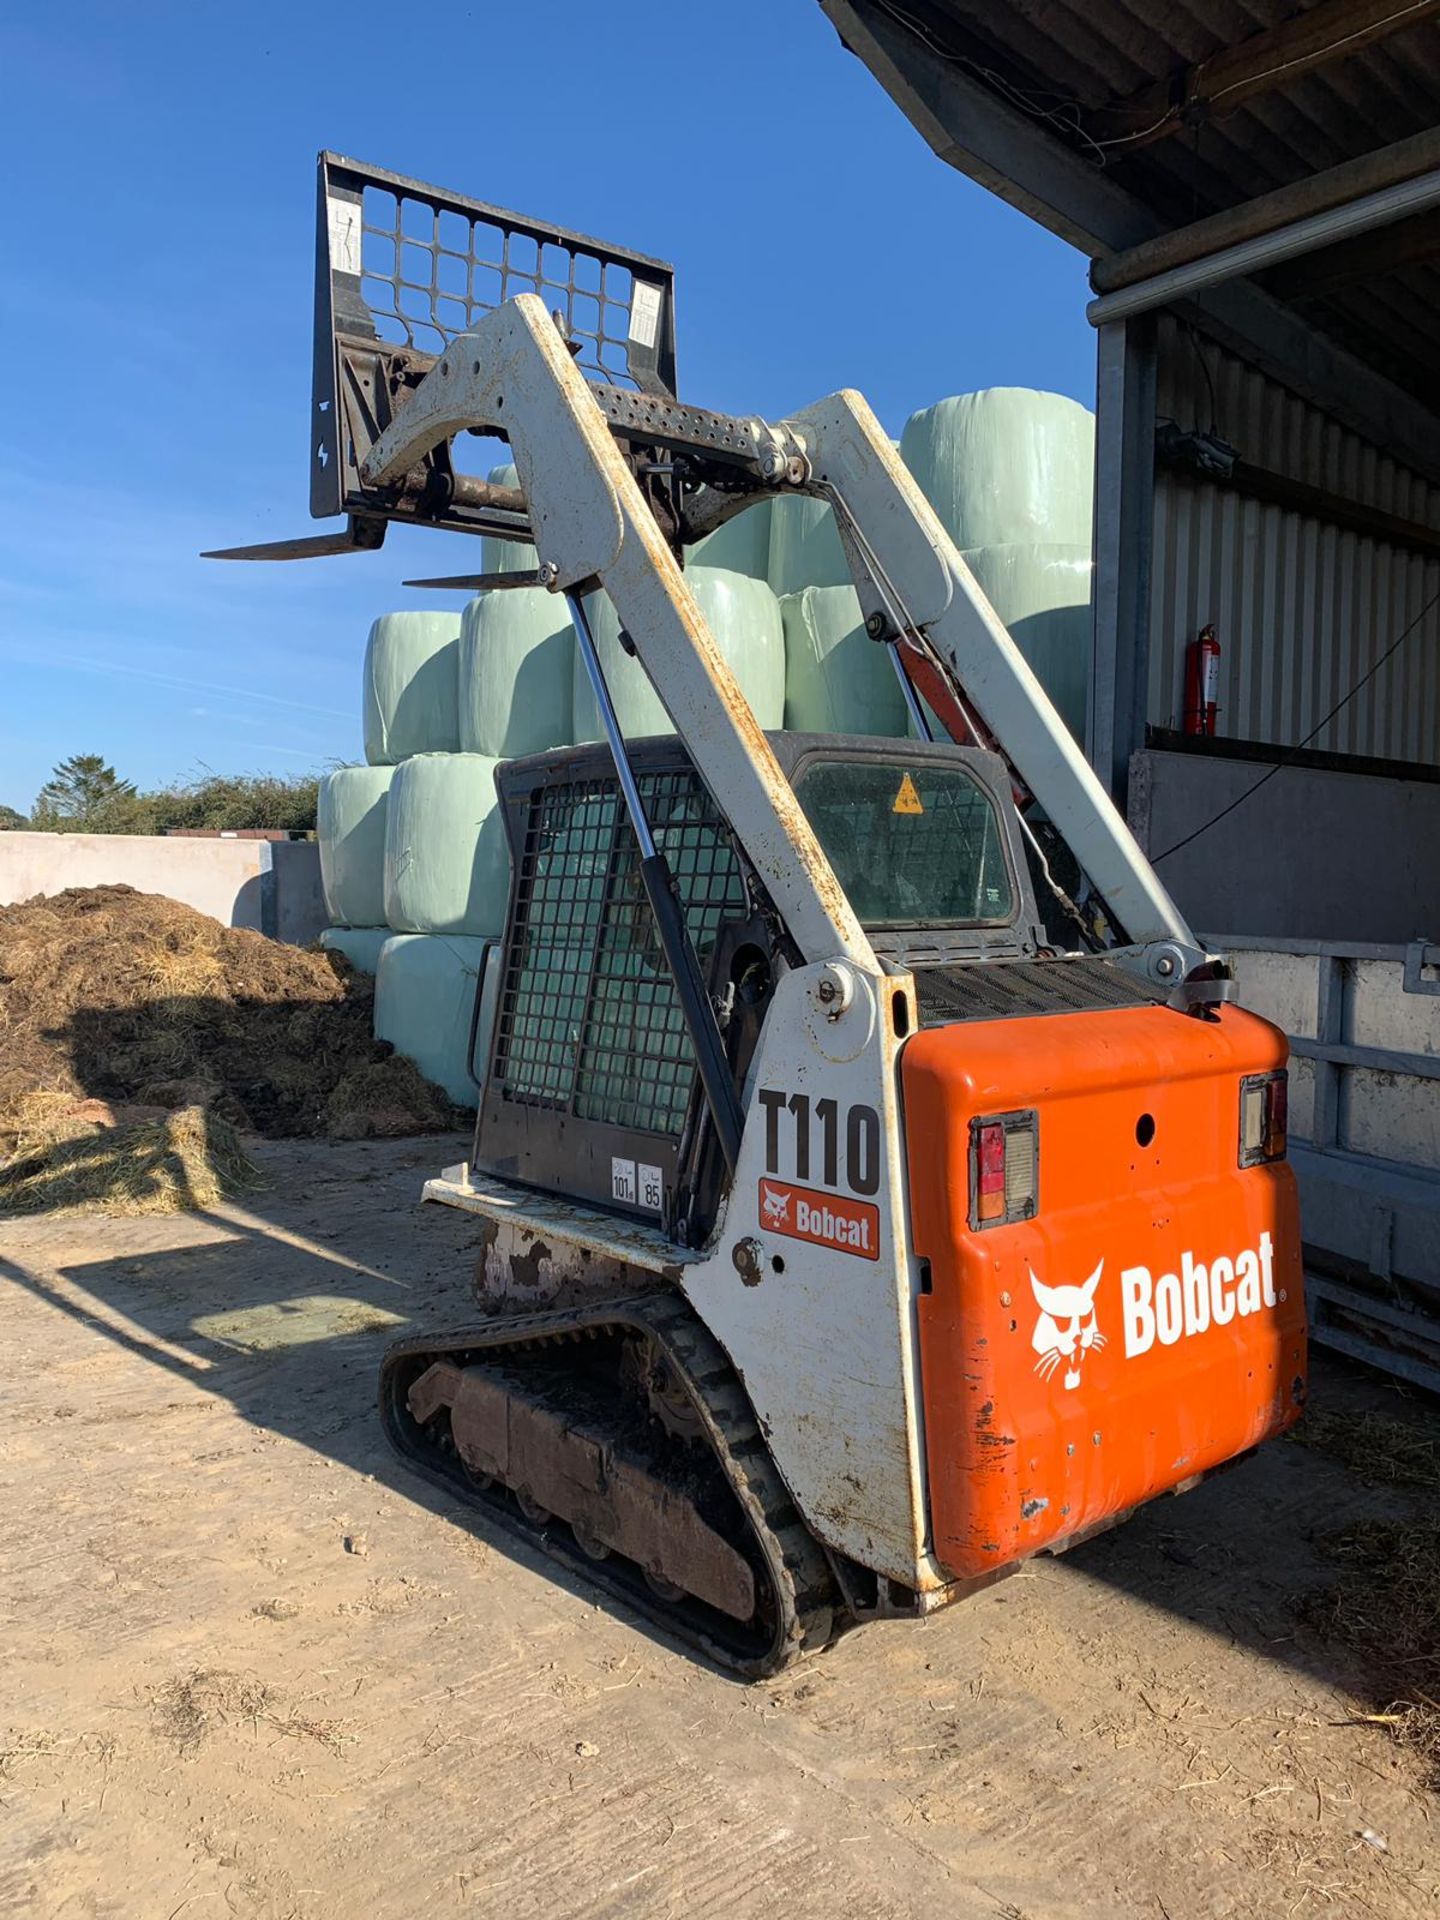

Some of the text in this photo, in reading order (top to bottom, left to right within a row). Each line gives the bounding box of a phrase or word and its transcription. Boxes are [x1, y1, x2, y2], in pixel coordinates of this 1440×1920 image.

[759, 1089, 880, 1196] T110
[614, 1176, 629, 1199] 101
[645, 1184, 660, 1207] 85
[796, 1200, 870, 1250] Bobcat
[1120, 1231, 1277, 1360] Bobcat
